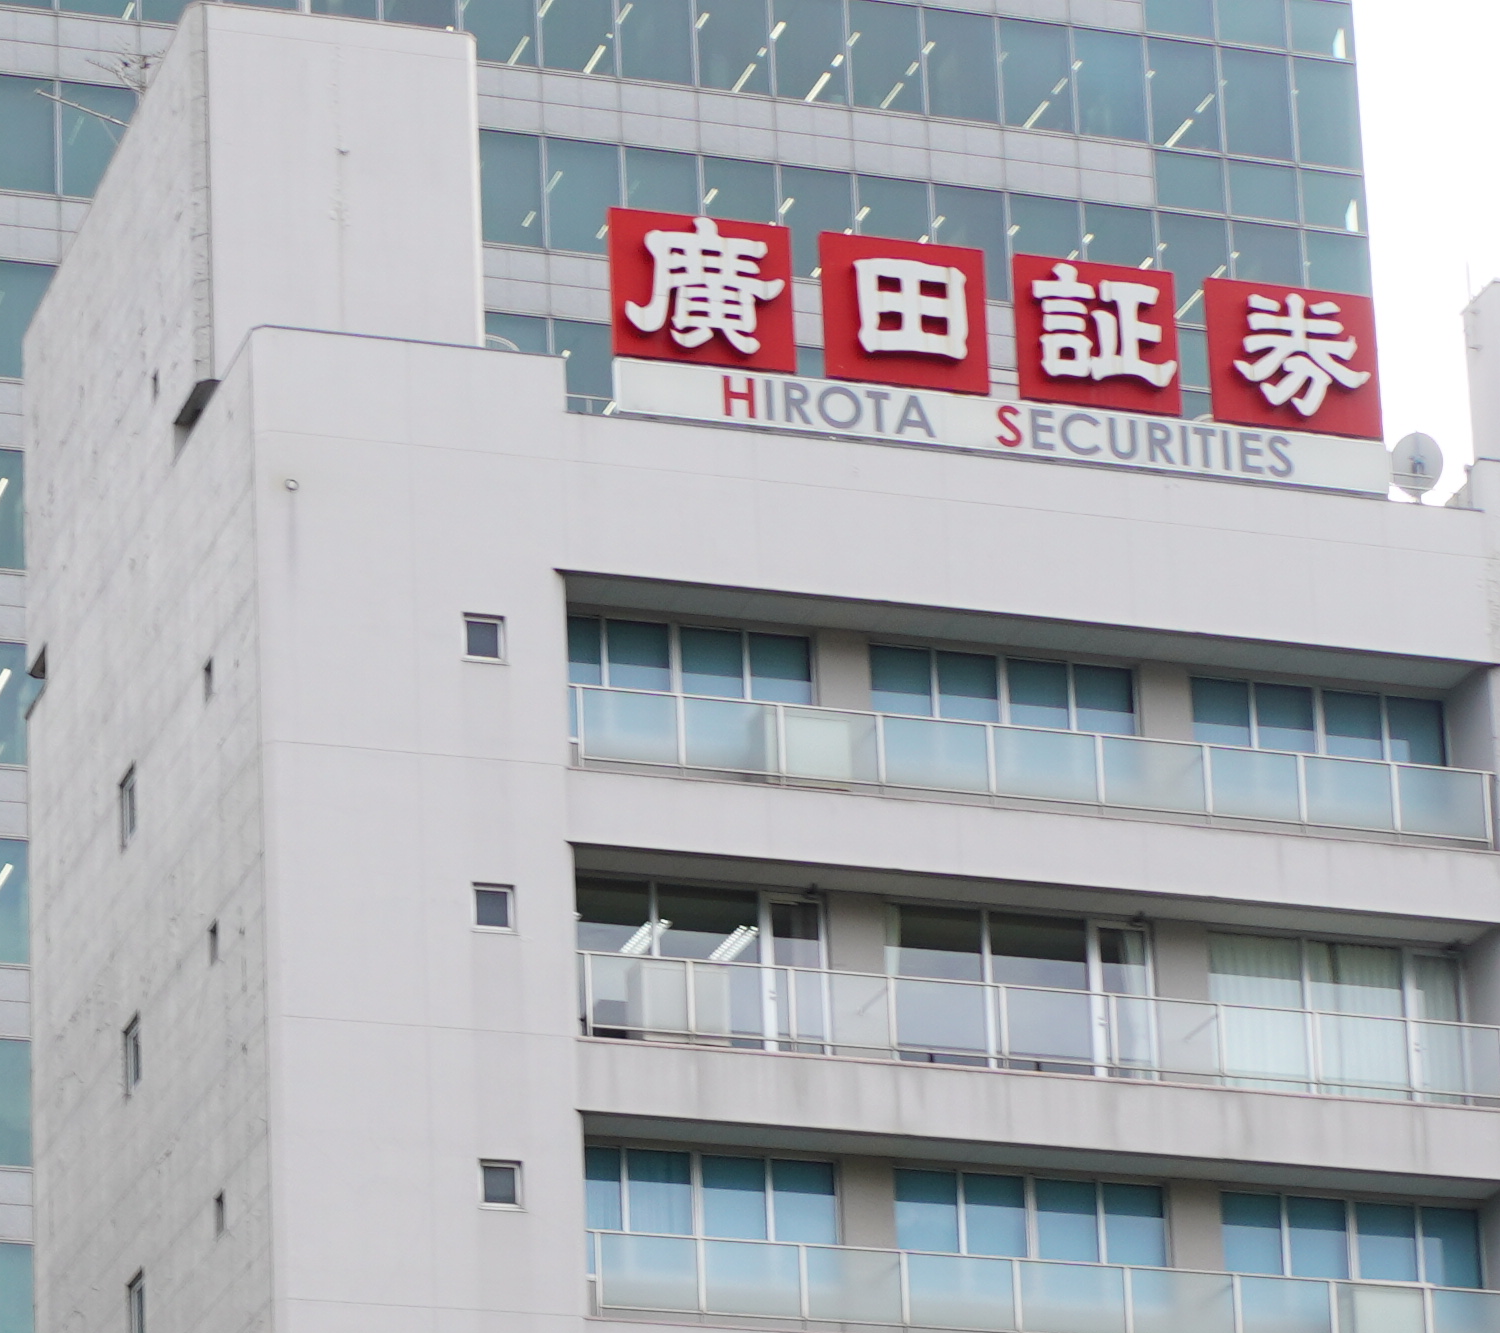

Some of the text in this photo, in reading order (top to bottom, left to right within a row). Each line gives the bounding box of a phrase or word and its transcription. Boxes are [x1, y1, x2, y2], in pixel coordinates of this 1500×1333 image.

[625, 217, 1370, 416] 廣田証券
[722, 375, 1293, 478] HIROTA SECURITIES
